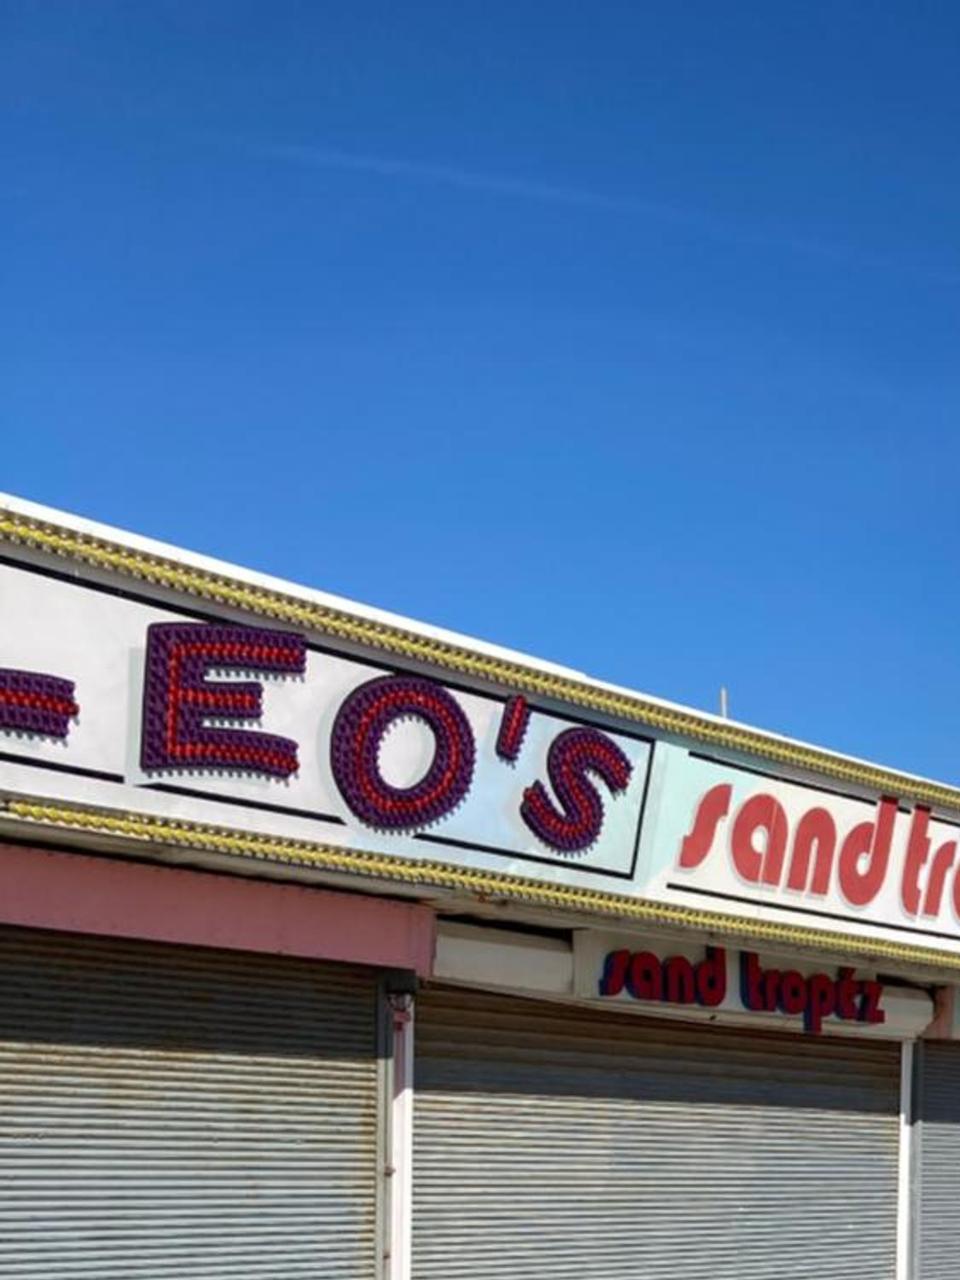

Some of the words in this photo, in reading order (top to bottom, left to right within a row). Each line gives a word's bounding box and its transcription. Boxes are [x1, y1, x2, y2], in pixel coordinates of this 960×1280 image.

[0, 621, 635, 858] EO'S
[677, 783, 899, 907] sand
[599, 945, 727, 1006] sand
